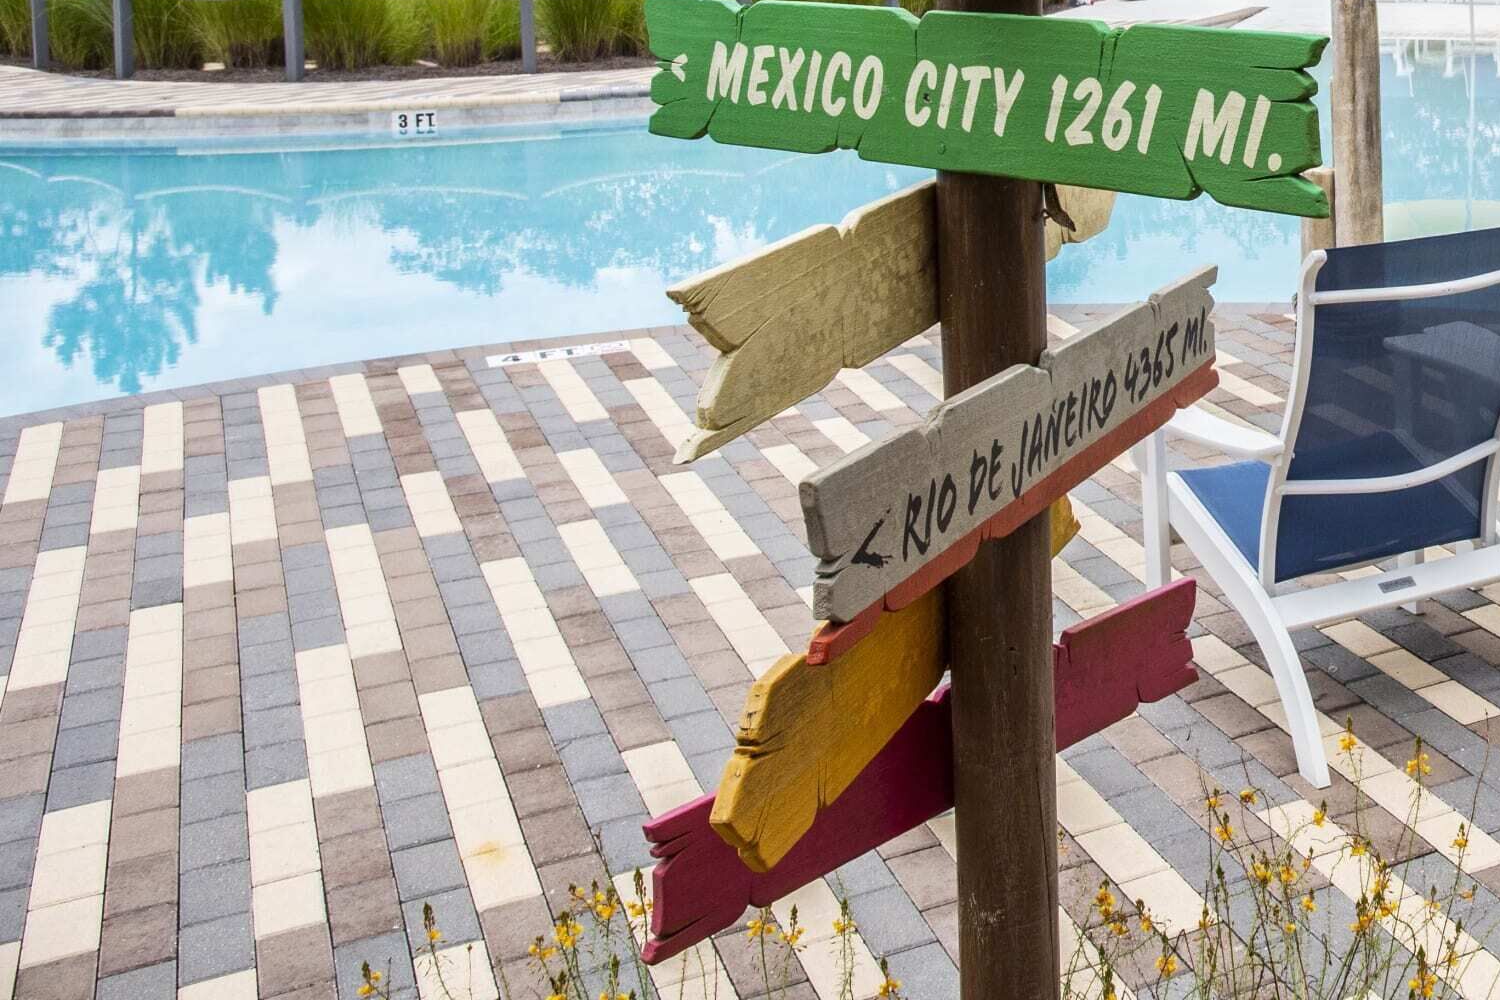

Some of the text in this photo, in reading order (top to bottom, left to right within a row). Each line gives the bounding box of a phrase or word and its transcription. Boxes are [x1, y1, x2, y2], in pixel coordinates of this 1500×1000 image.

[398, 114, 408, 128] 3
[706, 40, 1283, 172] MEXICO CITY 1261 MI.
[902, 473, 957, 562] RIO
[967, 438, 1004, 516] DE
[1124, 321, 1178, 404] 4365
